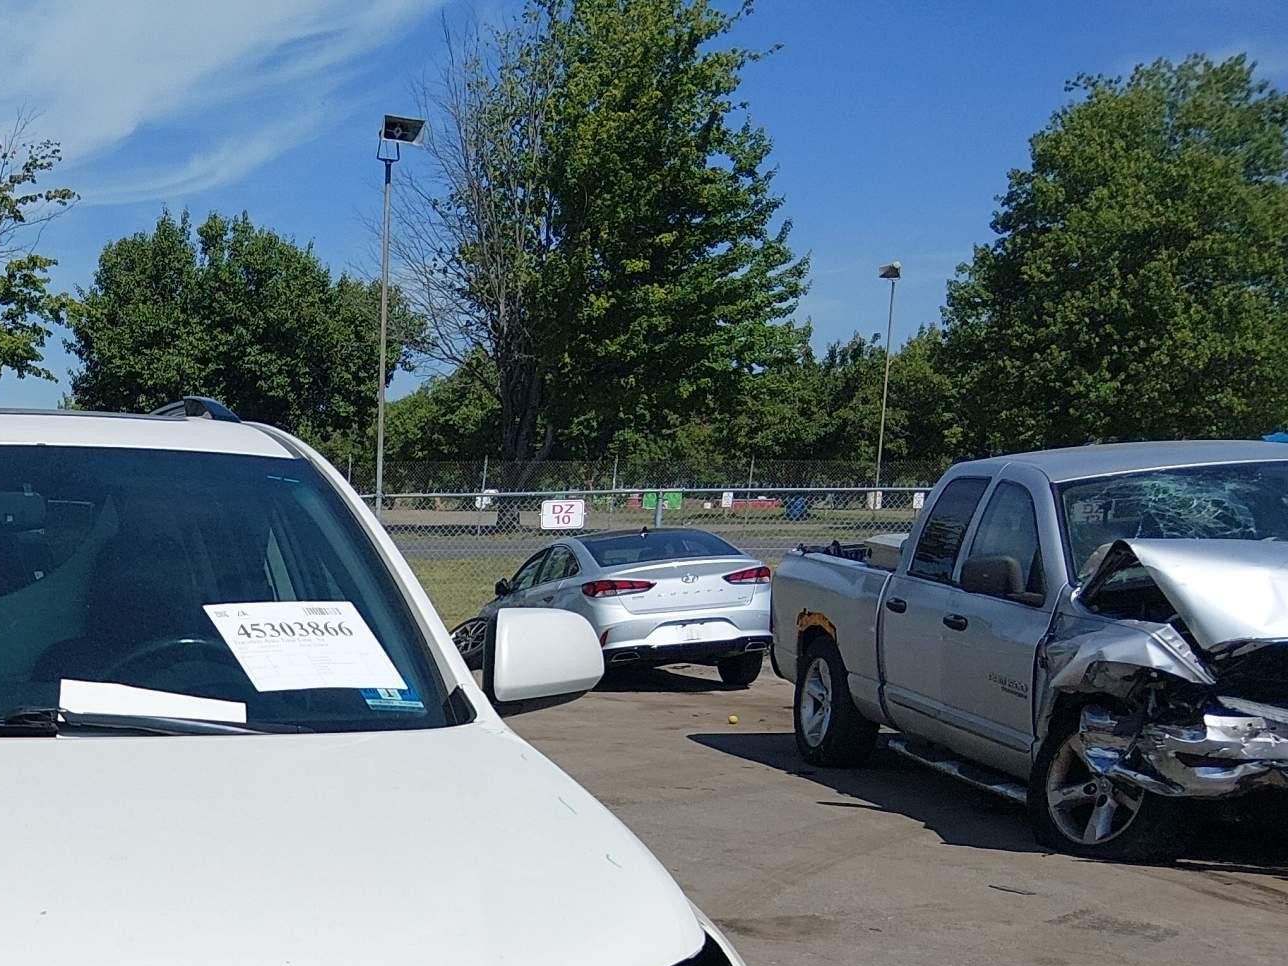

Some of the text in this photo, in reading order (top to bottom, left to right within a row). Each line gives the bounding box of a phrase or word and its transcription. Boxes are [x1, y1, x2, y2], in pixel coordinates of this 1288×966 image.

[552, 504, 574, 514] DZ
[554, 515, 570, 525] 10
[237, 621, 353, 639] 45303866
